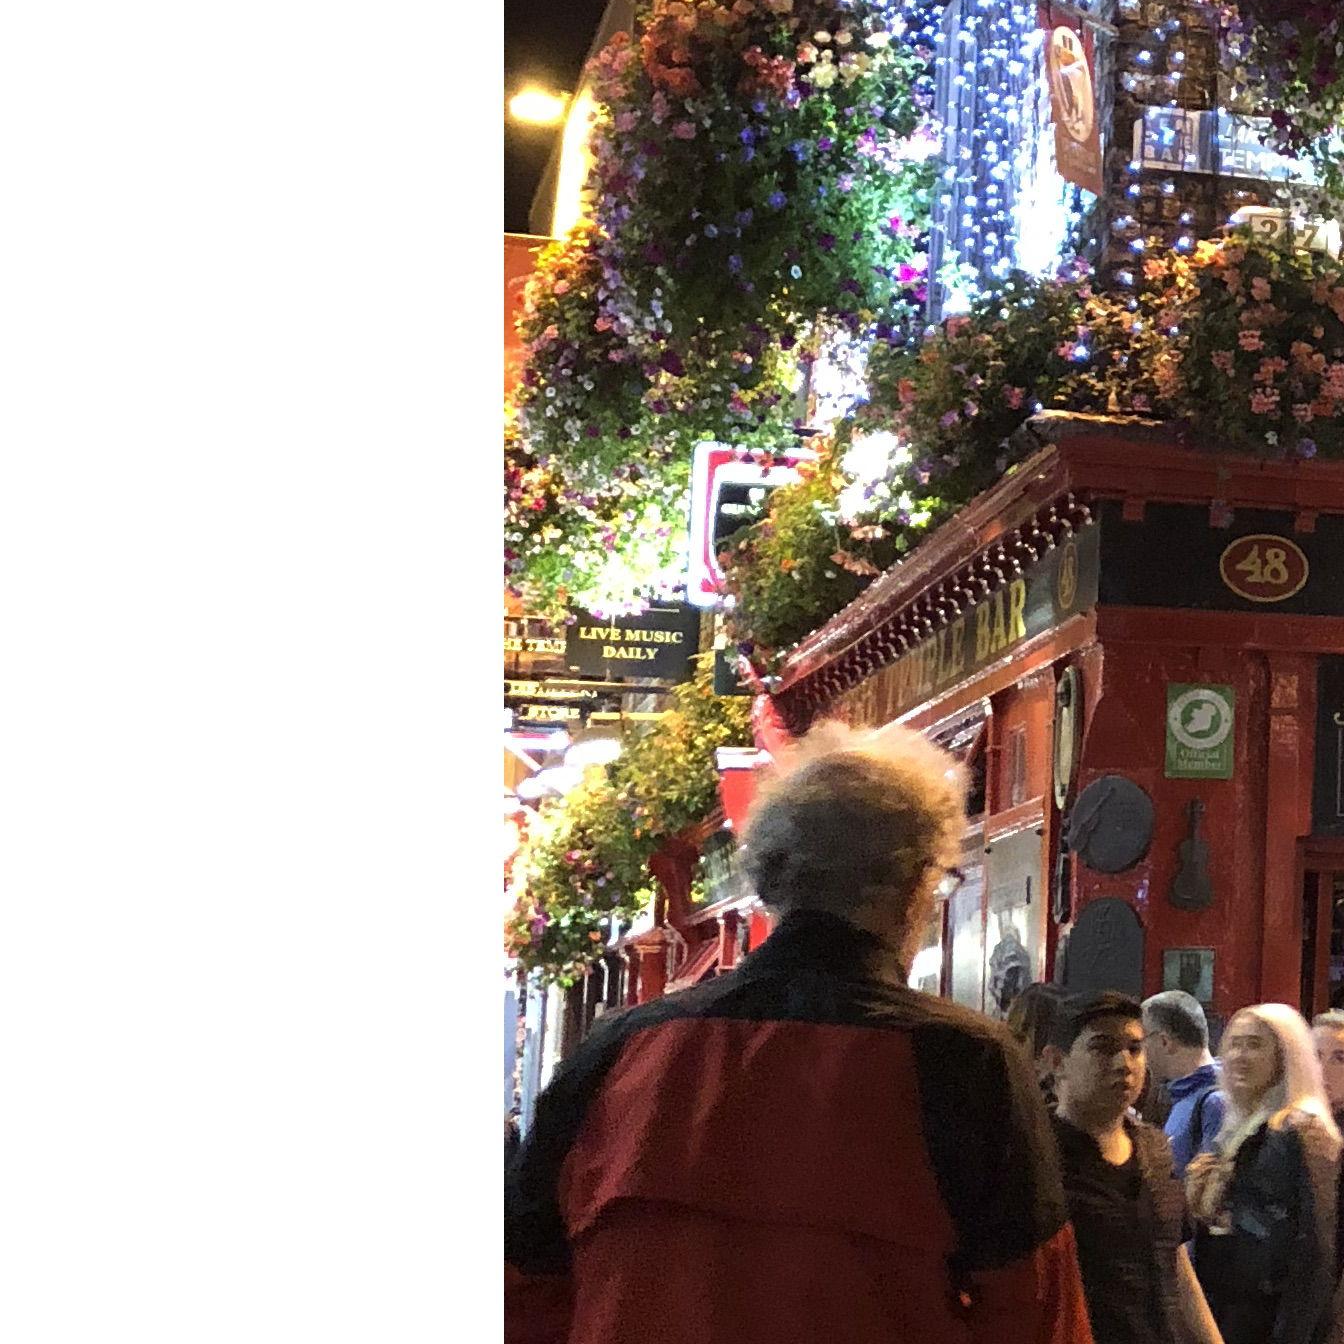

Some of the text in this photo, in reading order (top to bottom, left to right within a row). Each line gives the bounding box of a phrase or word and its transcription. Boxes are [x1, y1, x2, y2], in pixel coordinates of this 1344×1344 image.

[1235, 544, 1288, 584] 48
[579, 627, 684, 644] LIVE MUSIC
[603, 645, 659, 660] DAILY
